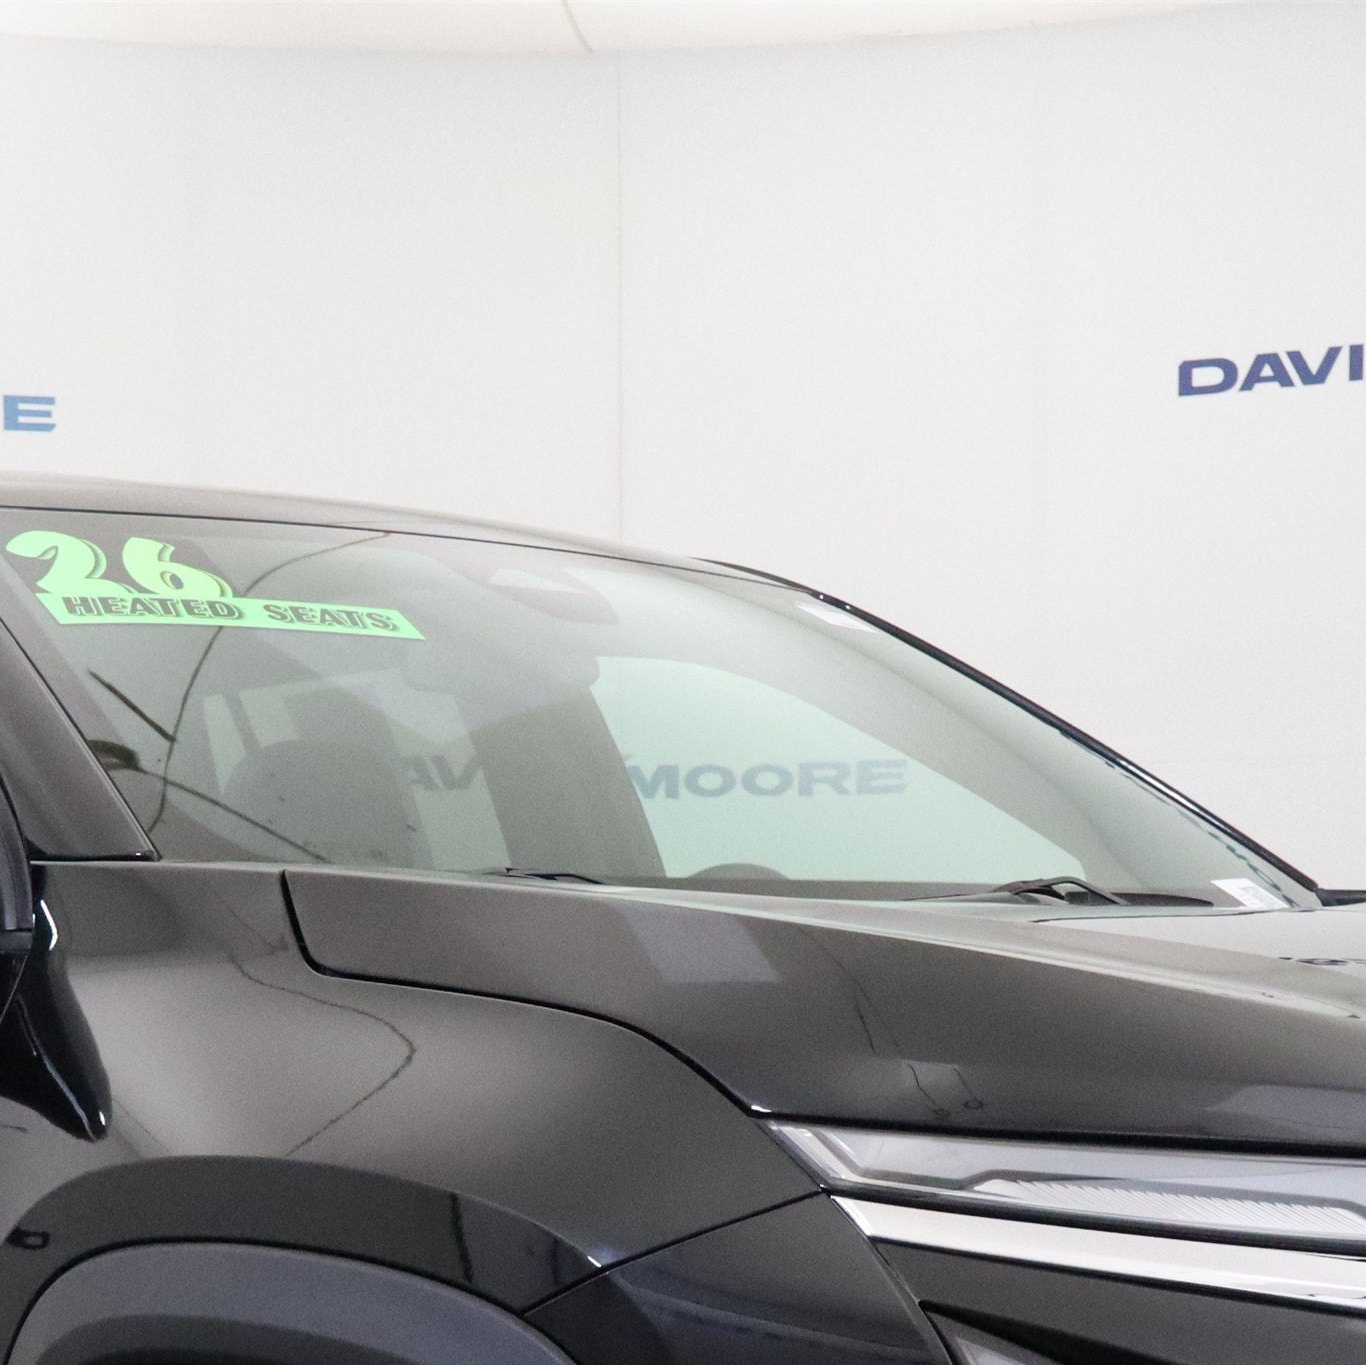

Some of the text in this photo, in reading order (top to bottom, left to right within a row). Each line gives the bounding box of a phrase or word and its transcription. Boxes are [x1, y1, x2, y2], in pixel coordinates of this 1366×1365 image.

[5, 530, 232, 597] 26
[63, 596, 400, 631] HEATED SEATS
